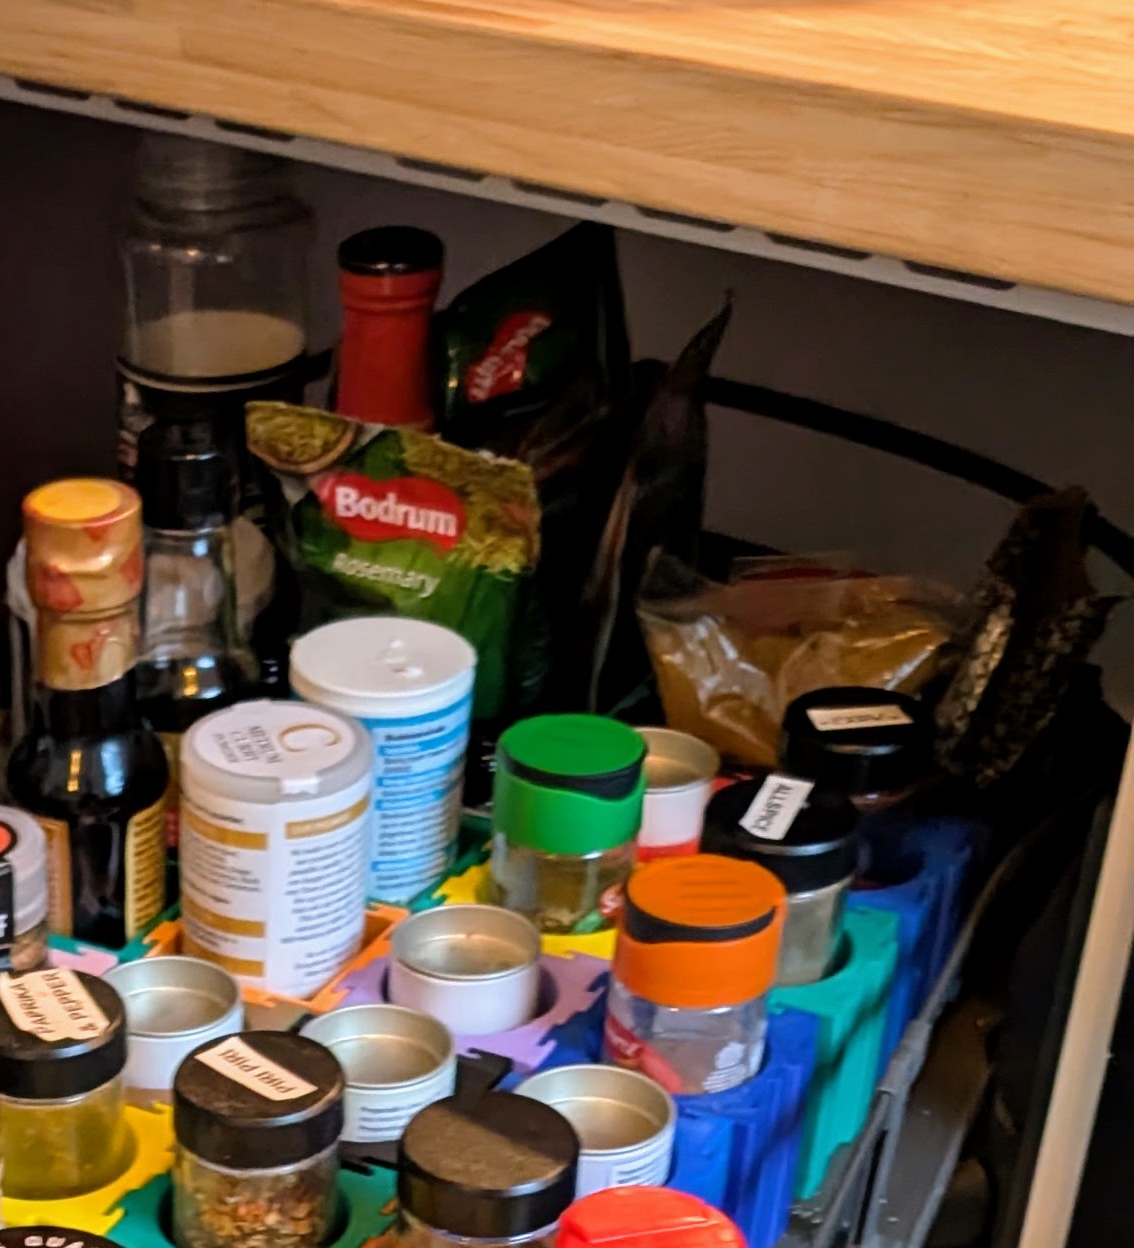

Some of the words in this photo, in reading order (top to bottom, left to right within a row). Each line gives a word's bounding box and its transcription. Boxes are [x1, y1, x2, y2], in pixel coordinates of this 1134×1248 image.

[335, 486, 457, 537] Bodrum
[333, 553, 441, 598] Rosemary
[752, 783, 794, 832] ALLSPICE
[9, 983, 56, 1034] PAPRIKA
[41, 972, 88, 1021] PEPPER
[217, 1048, 262, 1073] PIRI
[254, 1071, 298, 1094] PIRI
